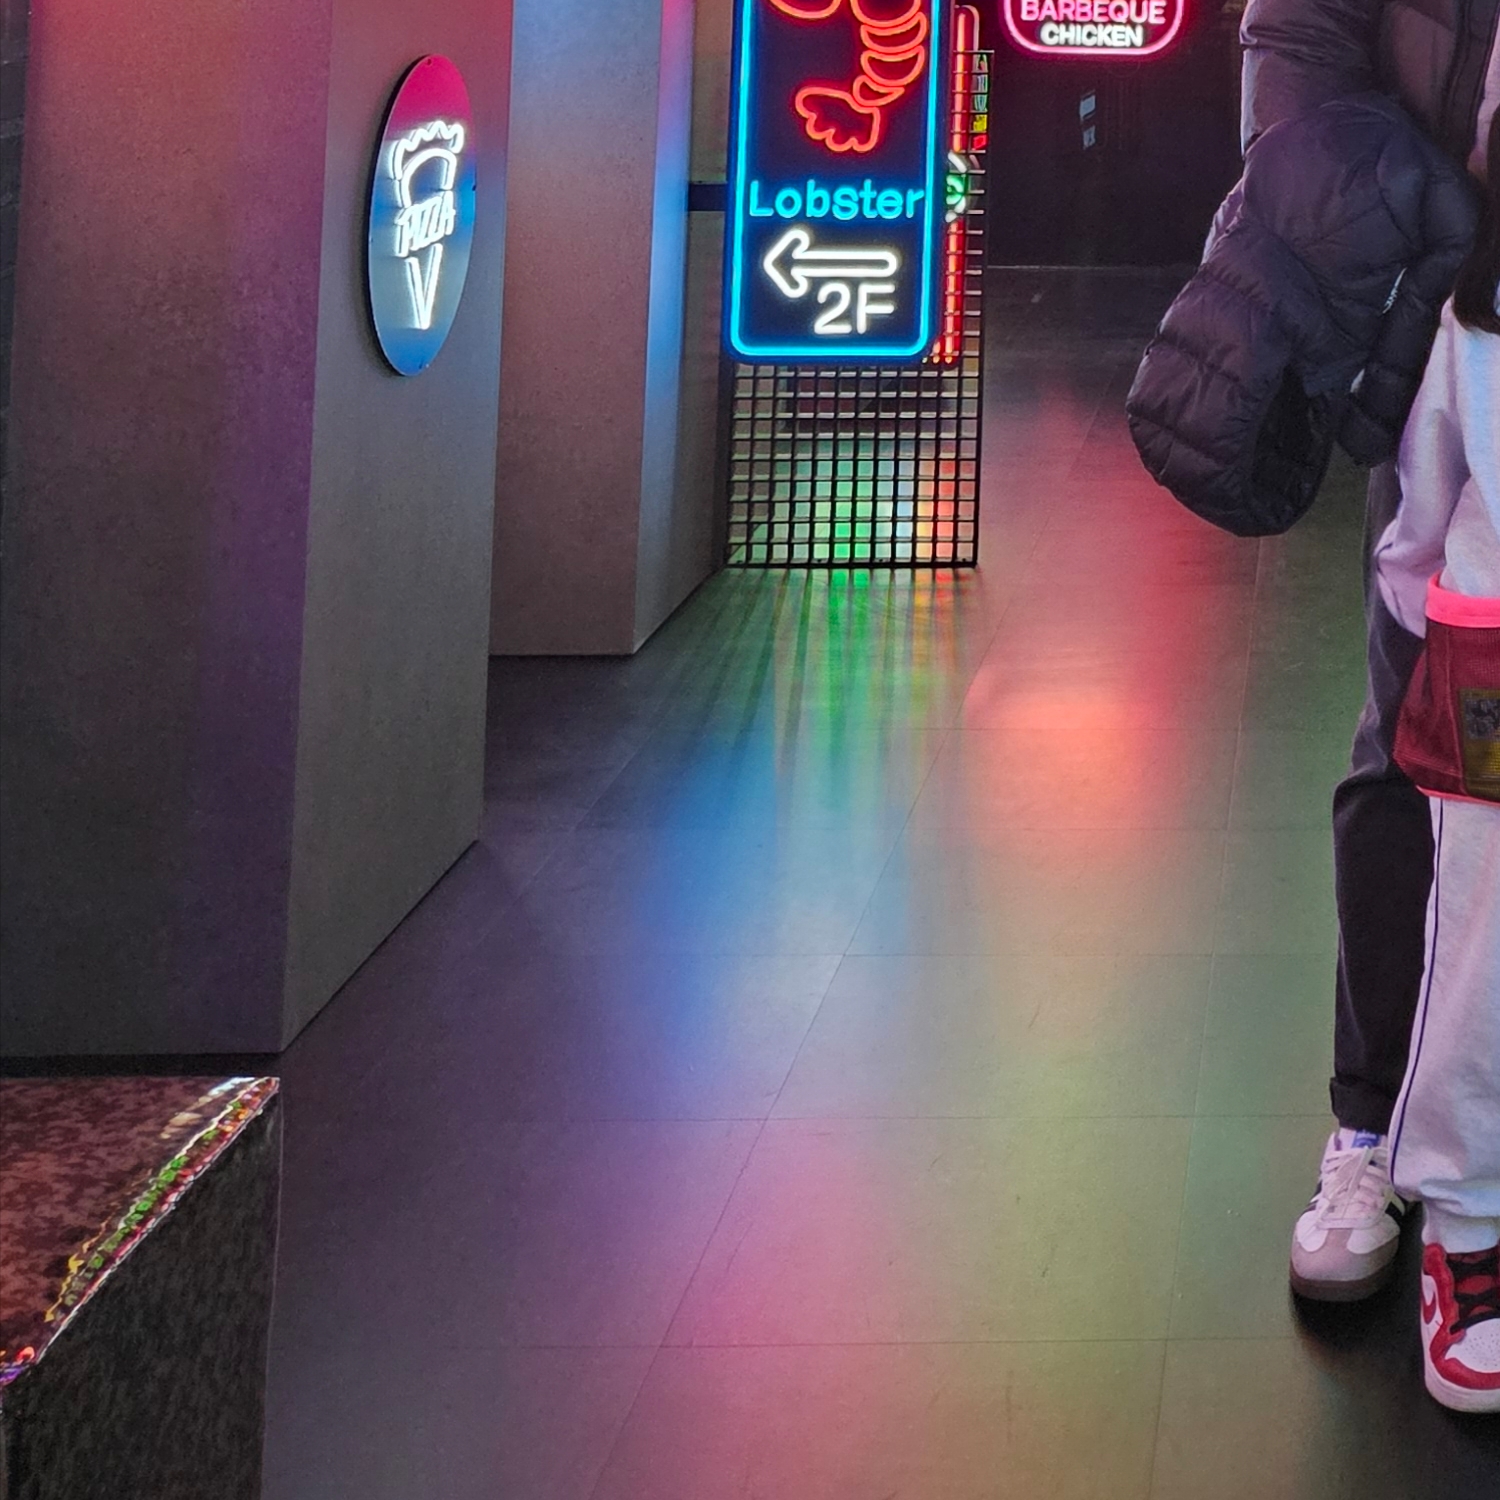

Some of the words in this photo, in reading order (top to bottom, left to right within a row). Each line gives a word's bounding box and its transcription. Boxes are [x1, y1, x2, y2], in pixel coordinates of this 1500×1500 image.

[1040, 22, 1144, 47] CHICKEN
[749, 180, 926, 220] Lobster
[396, 193, 456, 257] PIZZA
[814, 281, 896, 335] 2F
